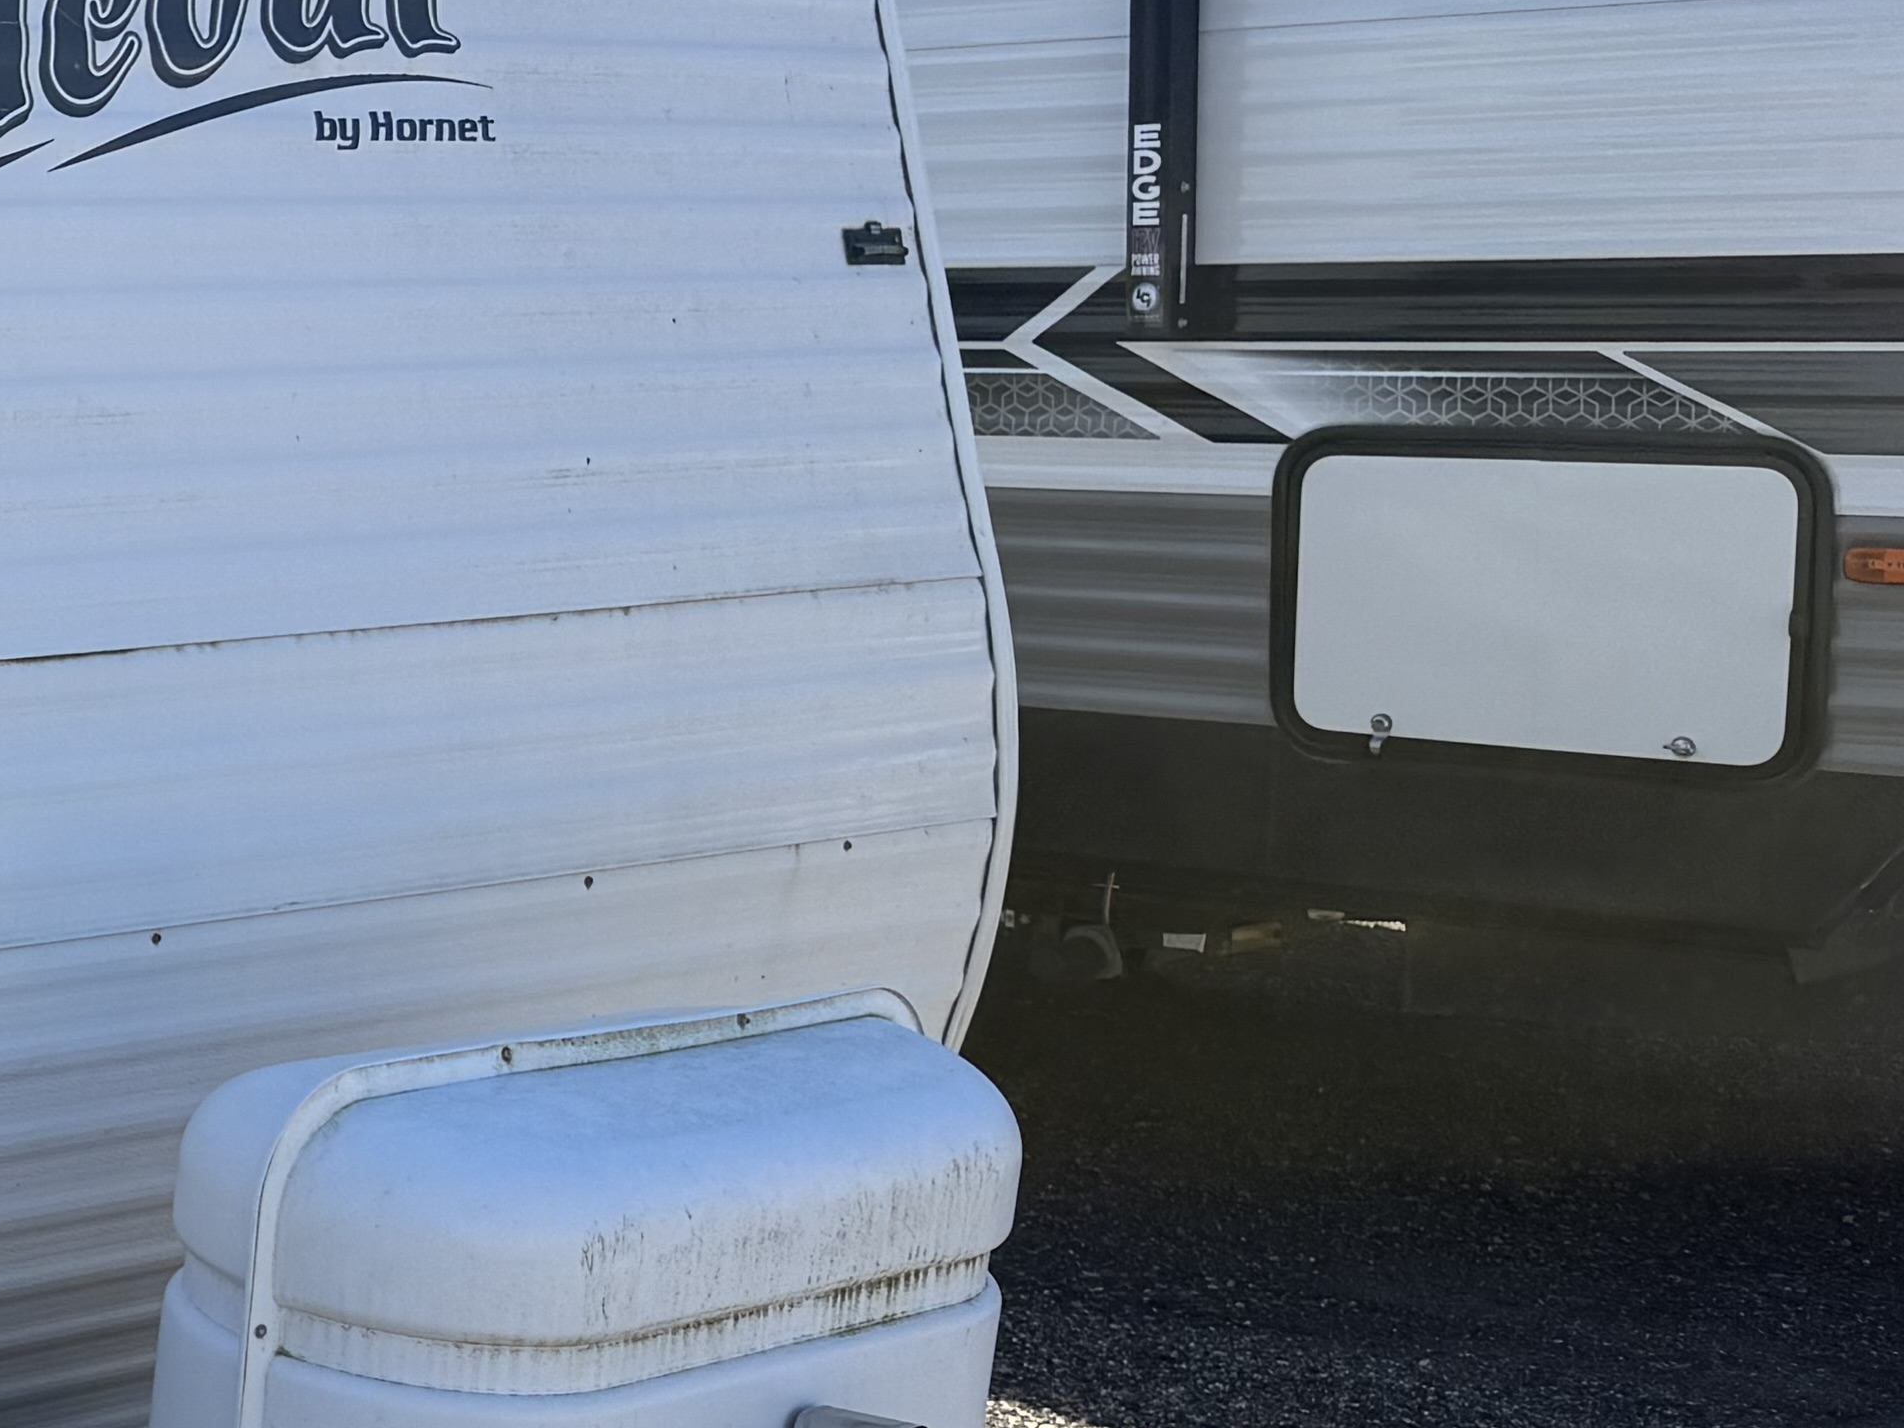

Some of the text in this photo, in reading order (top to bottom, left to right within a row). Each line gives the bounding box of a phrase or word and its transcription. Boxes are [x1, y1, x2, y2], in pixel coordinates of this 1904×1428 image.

[314, 110, 496, 150] by Hornet
[1132, 123, 1162, 226] EDGE
